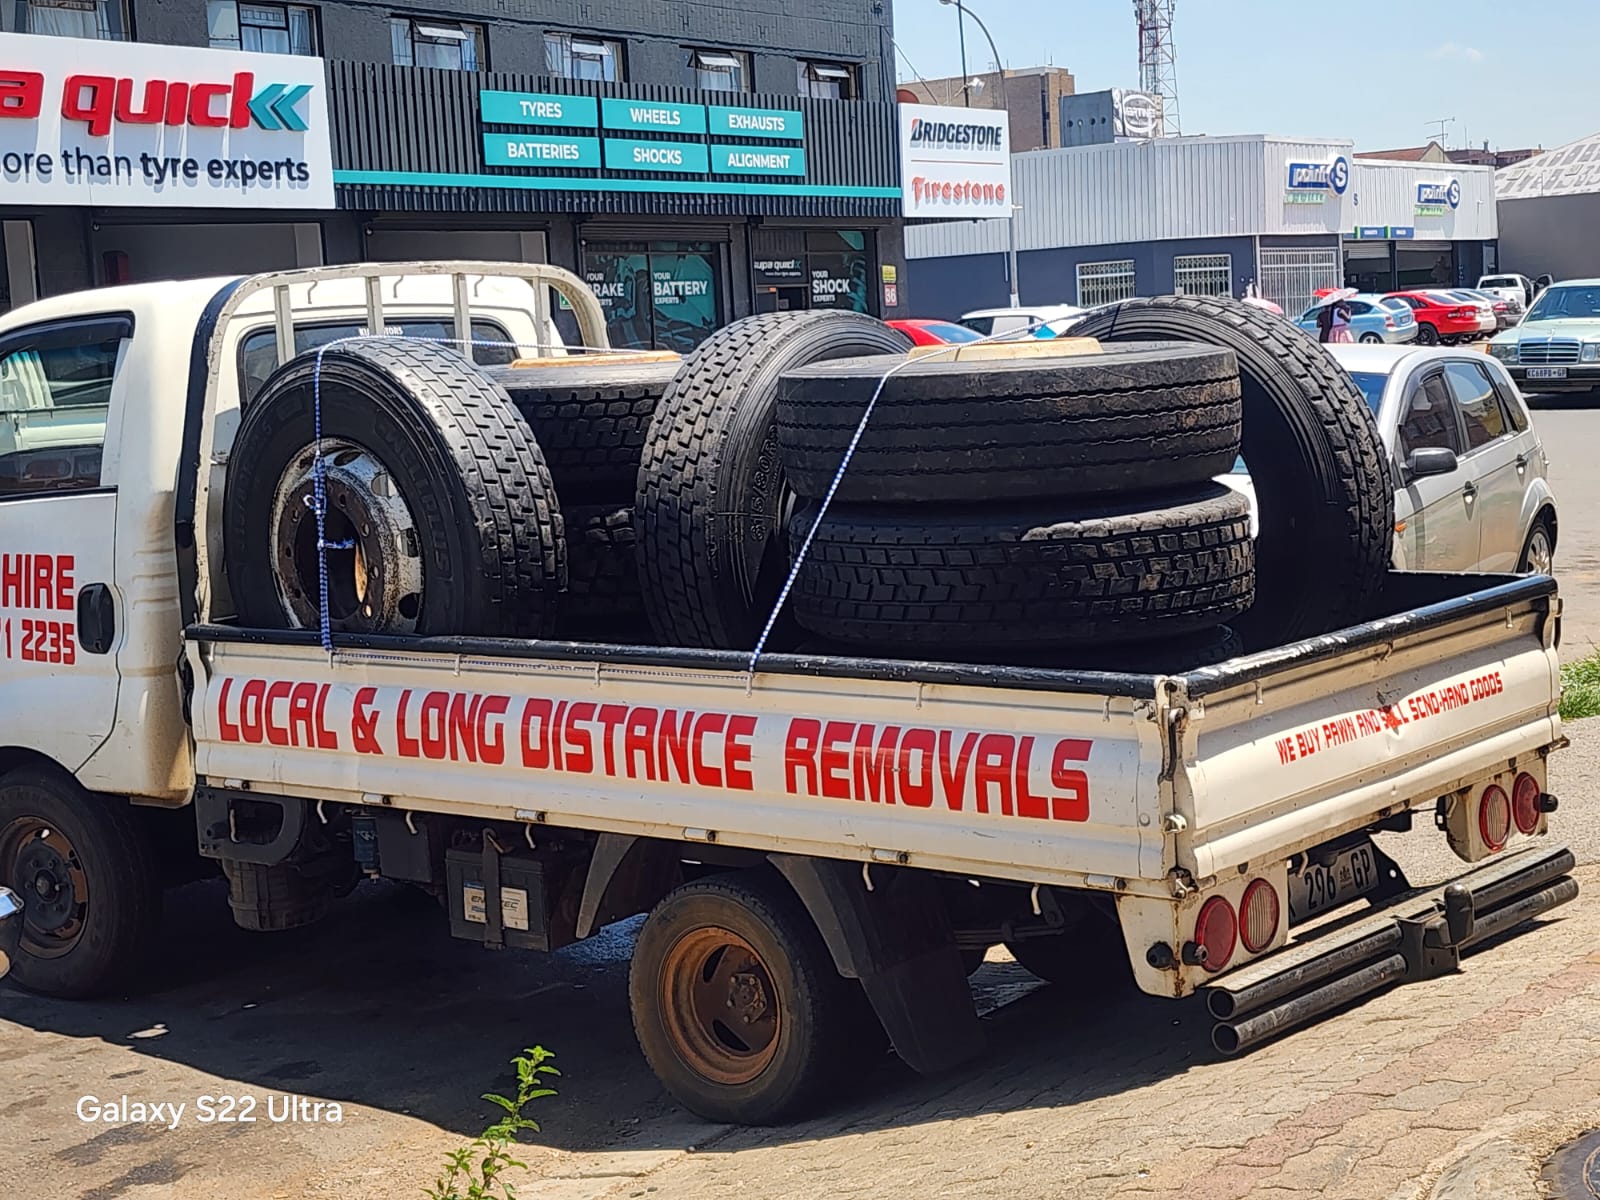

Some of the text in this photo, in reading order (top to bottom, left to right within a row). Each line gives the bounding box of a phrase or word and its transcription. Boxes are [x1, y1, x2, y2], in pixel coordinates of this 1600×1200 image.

[61, 71, 290, 137] quick
[519, 100, 563, 119] TYRES
[630, 107, 682, 126] WHEELS
[728, 114, 785, 131] EXHAUSTS
[911, 118, 1002, 147] BRIDGESTONE
[507, 142, 579, 161] BATTERIES
[633, 147, 683, 166] SHOCKS
[0, 147, 310, 186] ore than tyre experts
[728, 153, 790, 170] ALIGNMENT
[911, 176, 1006, 206] Firestone
[653, 272, 671, 280] YOUR
[812, 270, 829, 279] YOUR
[653, 280, 708, 297] BATTERY
[812, 279, 850, 294] SHOCK
[654, 297, 680, 305] EXPERTS
[813, 294, 836, 303] EXPERTS
[2, 553, 75, 611] HIRE
[0, 617, 76, 665] 1 2235
[1275, 733, 1297, 765] WE
[1295, 727, 1322, 758] BUY
[1323, 717, 1358, 748] PAWN
[1356, 711, 1381, 738] AND
[1470, 671, 1504, 702] GOODS
[218, 677, 1095, 822] LOCAL & LONG DISTANCE REMOVALS
[1303, 866, 1336, 911] 296
[1351, 848, 1371, 889] GP
